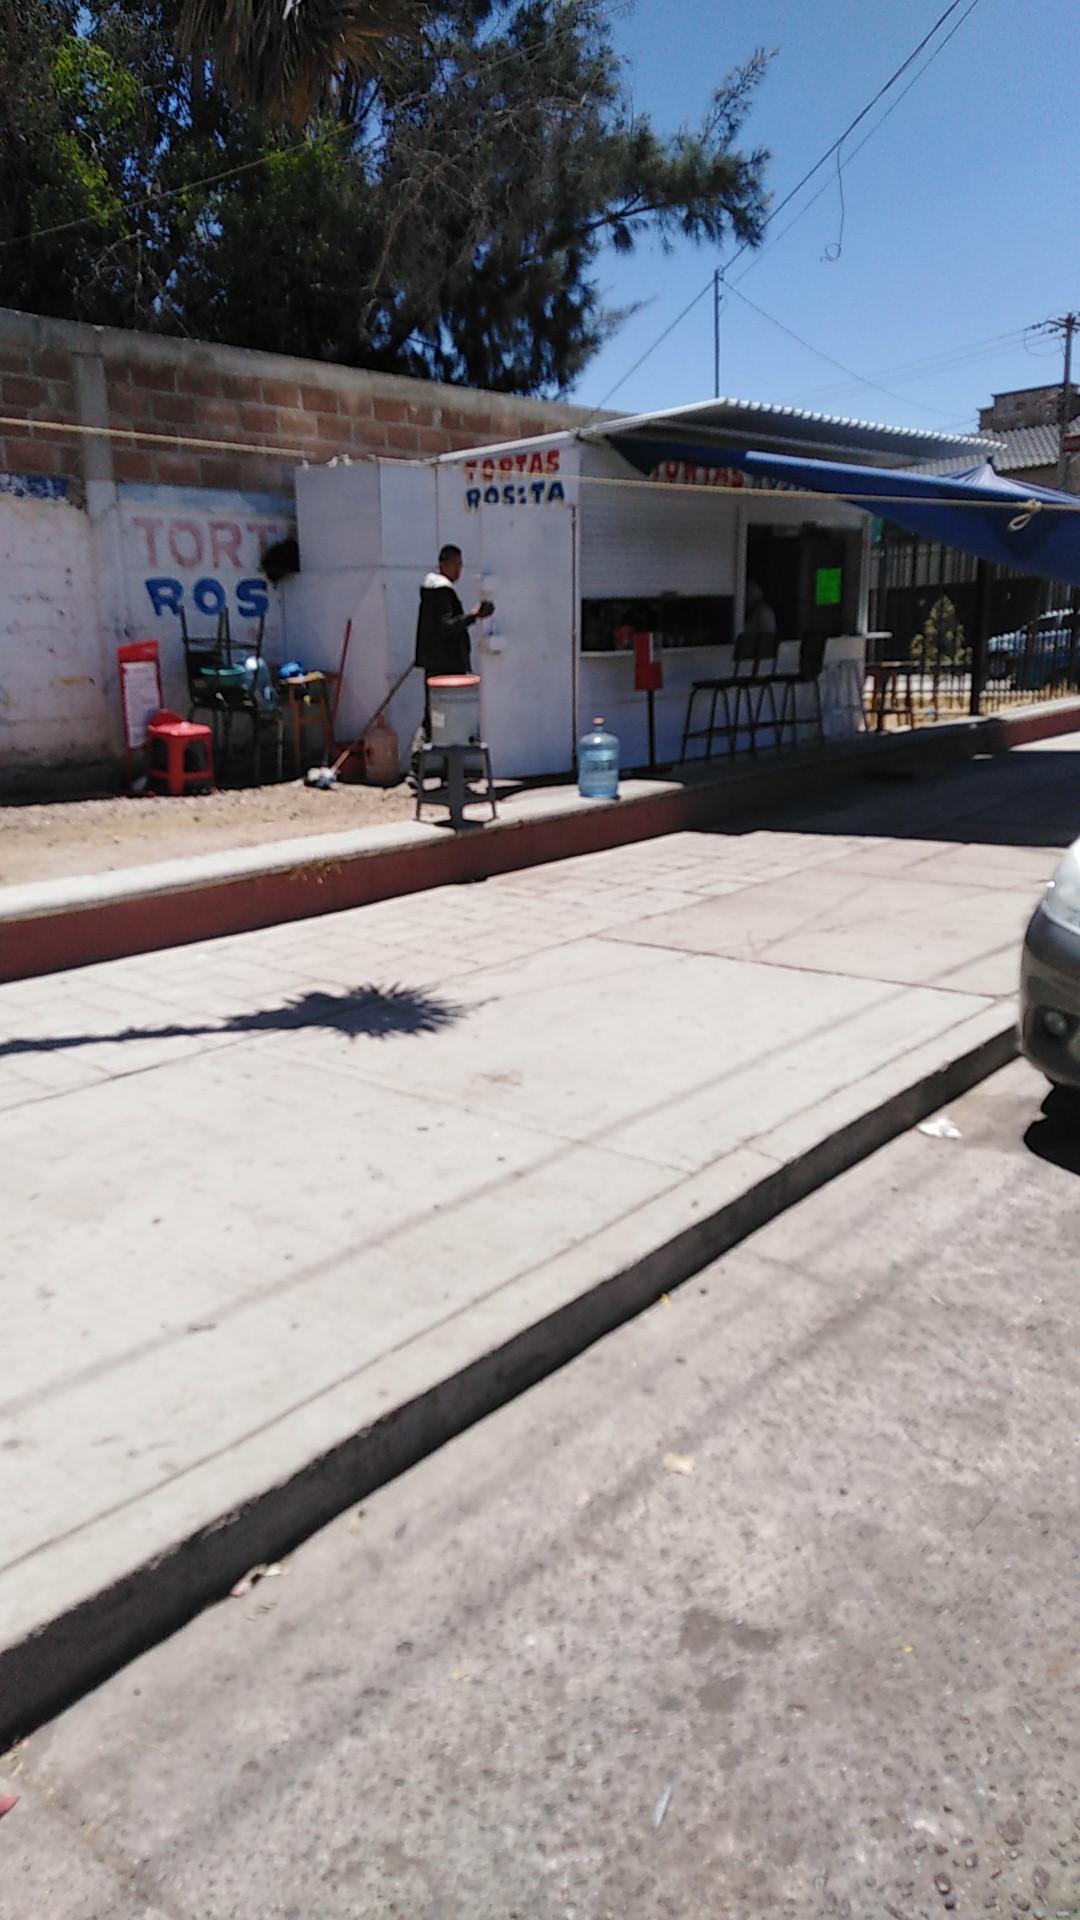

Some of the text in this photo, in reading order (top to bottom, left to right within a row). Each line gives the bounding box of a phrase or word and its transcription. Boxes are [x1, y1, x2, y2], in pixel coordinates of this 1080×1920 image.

[465, 449, 560, 481] TORTAS
[466, 480, 565, 508] ROSITA
[145, 577, 270, 618] ROS
